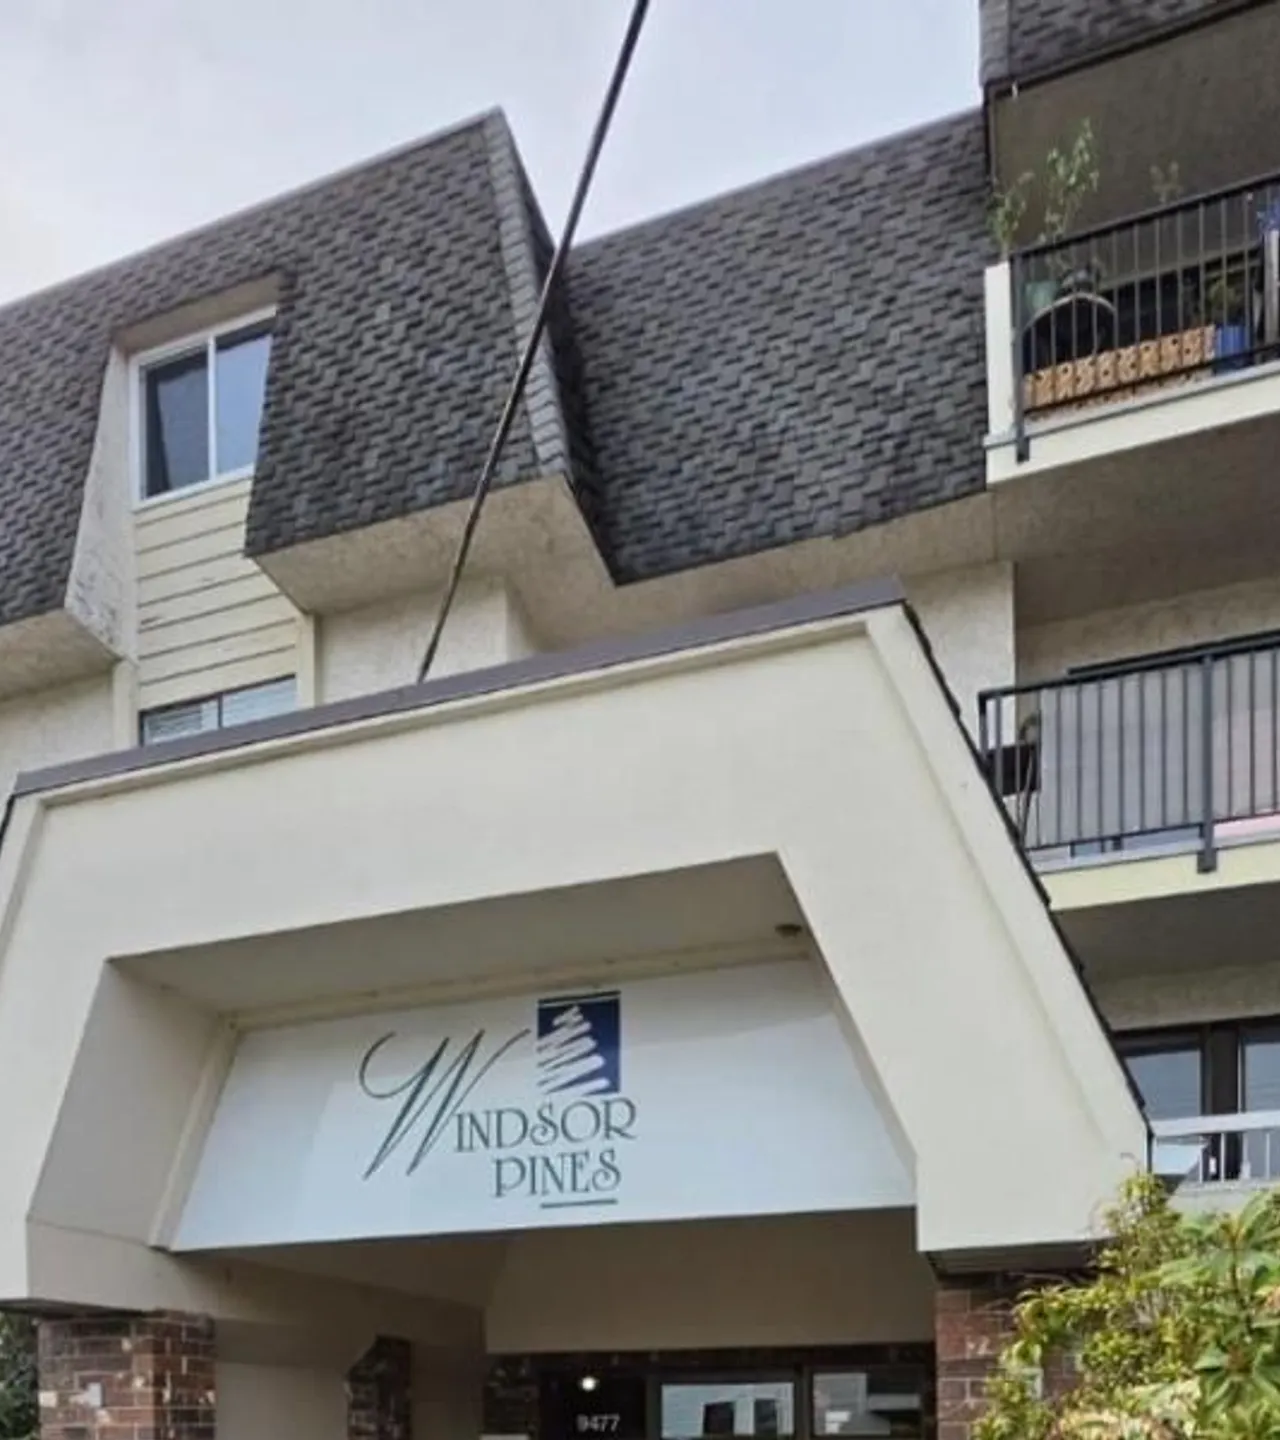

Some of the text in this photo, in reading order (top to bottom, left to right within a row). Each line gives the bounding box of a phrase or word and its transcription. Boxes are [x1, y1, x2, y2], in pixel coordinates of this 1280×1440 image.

[359, 1029, 637, 1181] WINDSOR
[493, 1149, 622, 1198] PINES
[577, 1413, 620, 1432] 9477
